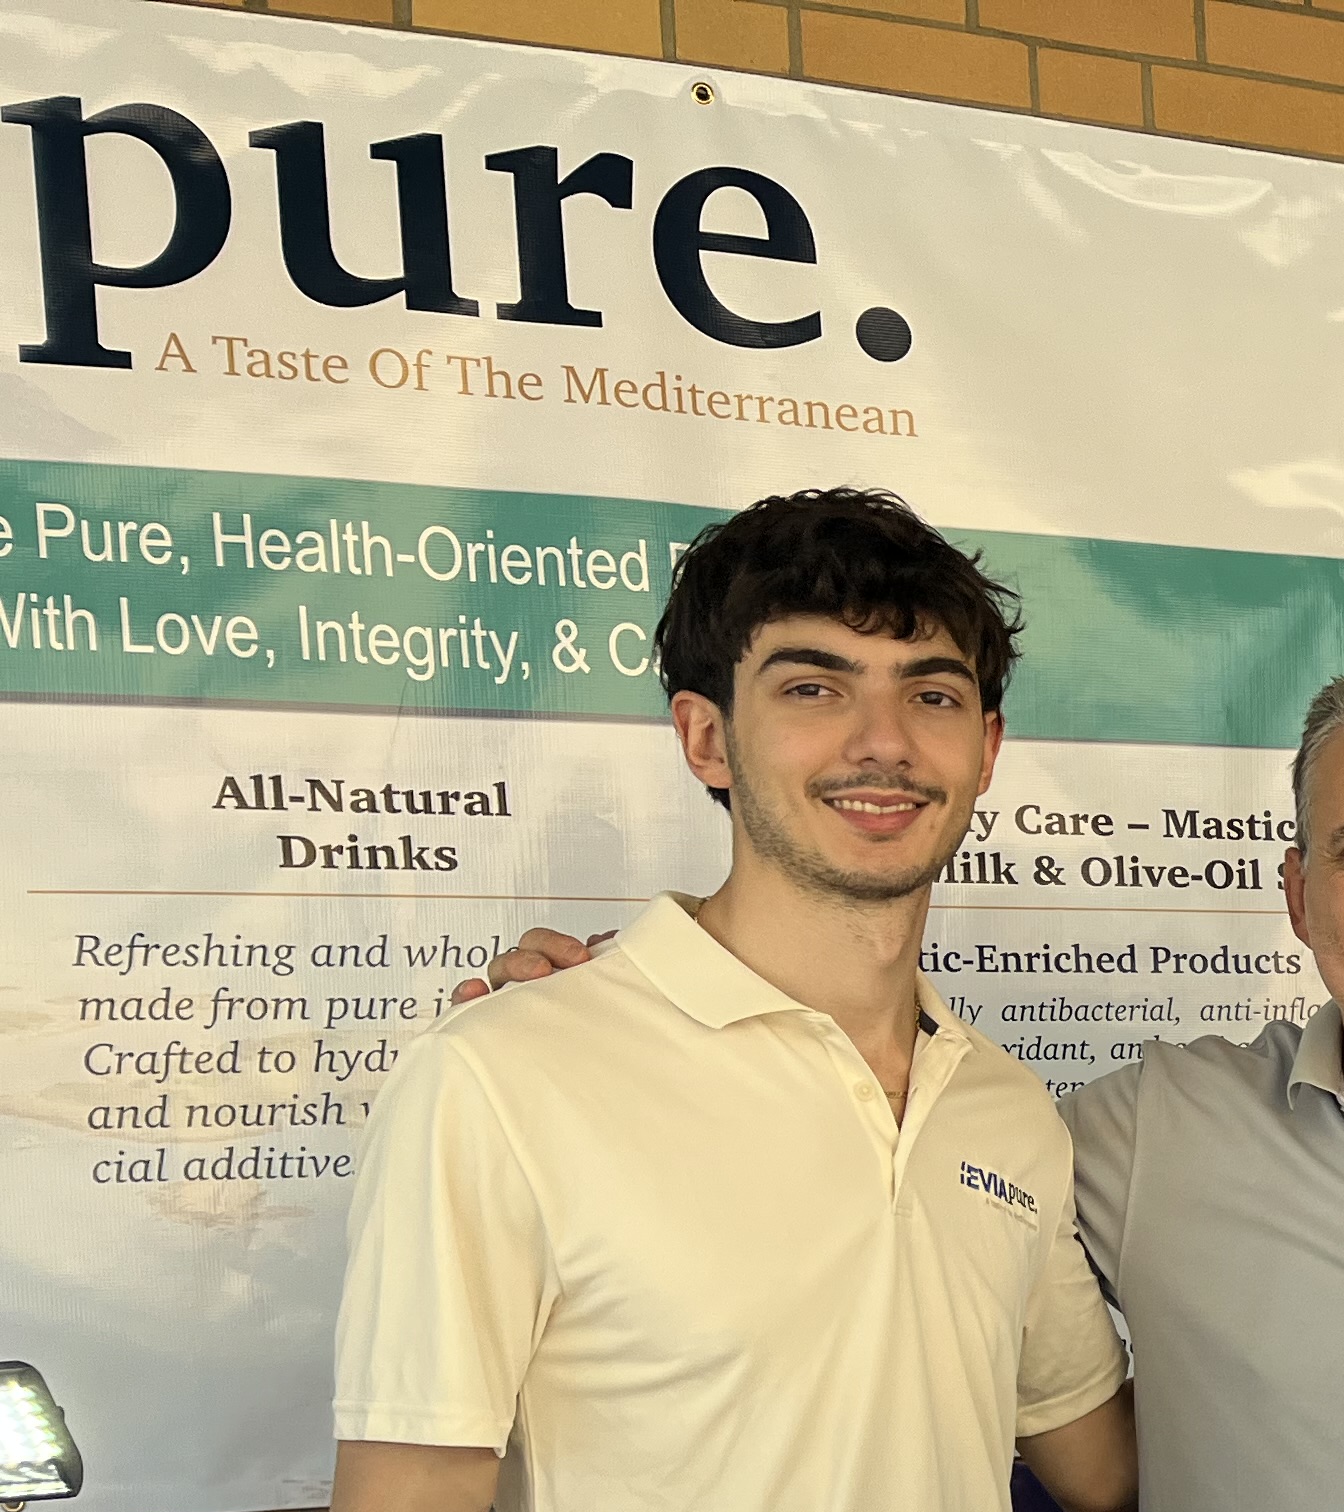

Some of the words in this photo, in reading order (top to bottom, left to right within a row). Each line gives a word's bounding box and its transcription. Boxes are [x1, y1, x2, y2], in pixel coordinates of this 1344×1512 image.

[0, 96, 912, 370] pure.
[155, 332, 196, 373] A
[212, 336, 350, 384] Taste
[369, 349, 430, 395] Of
[446, 355, 544, 403] The
[563, 366, 919, 438] Mediterranean
[35, 504, 191, 574] Pure,
[212, 512, 650, 591] Health-Oriented
[121, 599, 277, 669] Love,
[300, 605, 531, 682] Integrity,
[552, 621, 591, 674] &
[212, 774, 512, 816] All-Natural
[1015, 804, 1114, 838] Care
[1162, 808, 1296, 841] Mastic
[277, 834, 458, 872] Drinks
[1033, 855, 1066, 887] &
[1080, 856, 1262, 890] Olive-Oil
[72, 934, 296, 976] Refreshing
[310, 934, 390, 968] and
[1149, 945, 1302, 975] Products
[79, 986, 194, 1022] made
[204, 988, 310, 1029] from
[324, 996, 418, 1029] pure
[1001, 997, 1181, 1025] antibacterial,
[84, 1040, 242, 1081] Crafted
[257, 1045, 296, 1074] to
[87, 1095, 171, 1130] and
[185, 1093, 346, 1129] nourish
[92, 1150, 168, 1184] cial
[183, 1144, 356, 1181] additive
